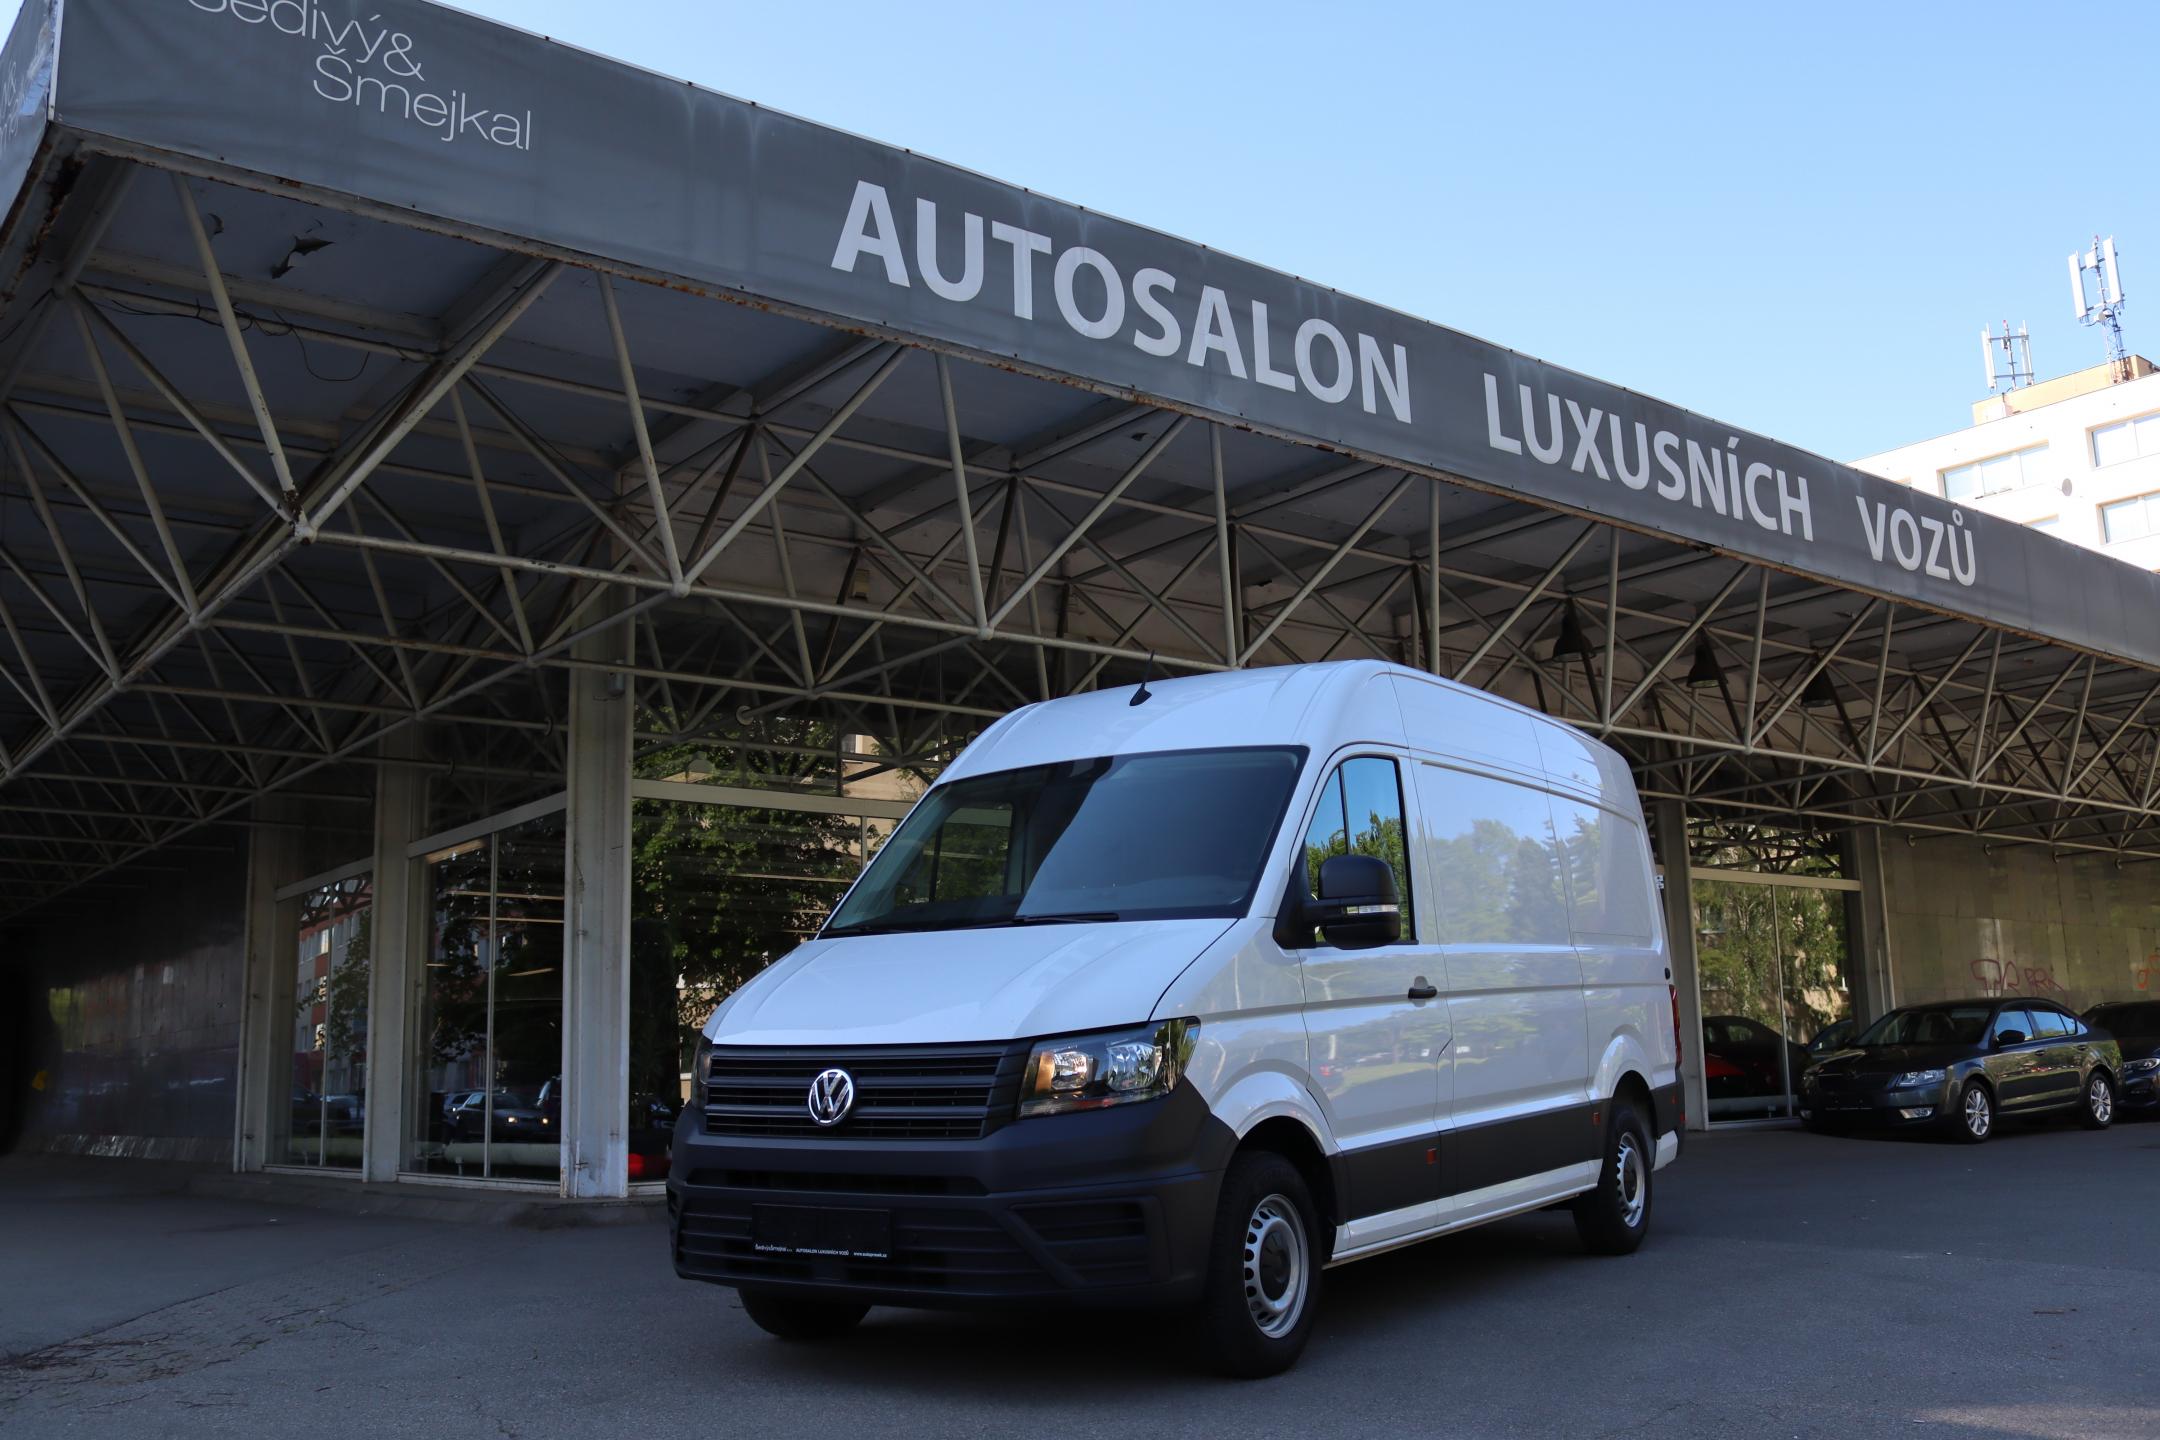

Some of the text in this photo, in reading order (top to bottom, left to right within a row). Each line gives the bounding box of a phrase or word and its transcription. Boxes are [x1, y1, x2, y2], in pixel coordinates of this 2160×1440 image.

[188, 0, 424, 81] edivý&
[313, 43, 531, 150] Šmejkal
[831, 180, 1977, 587] AUTOSALON LUXUSNÍCH VOZŮ
